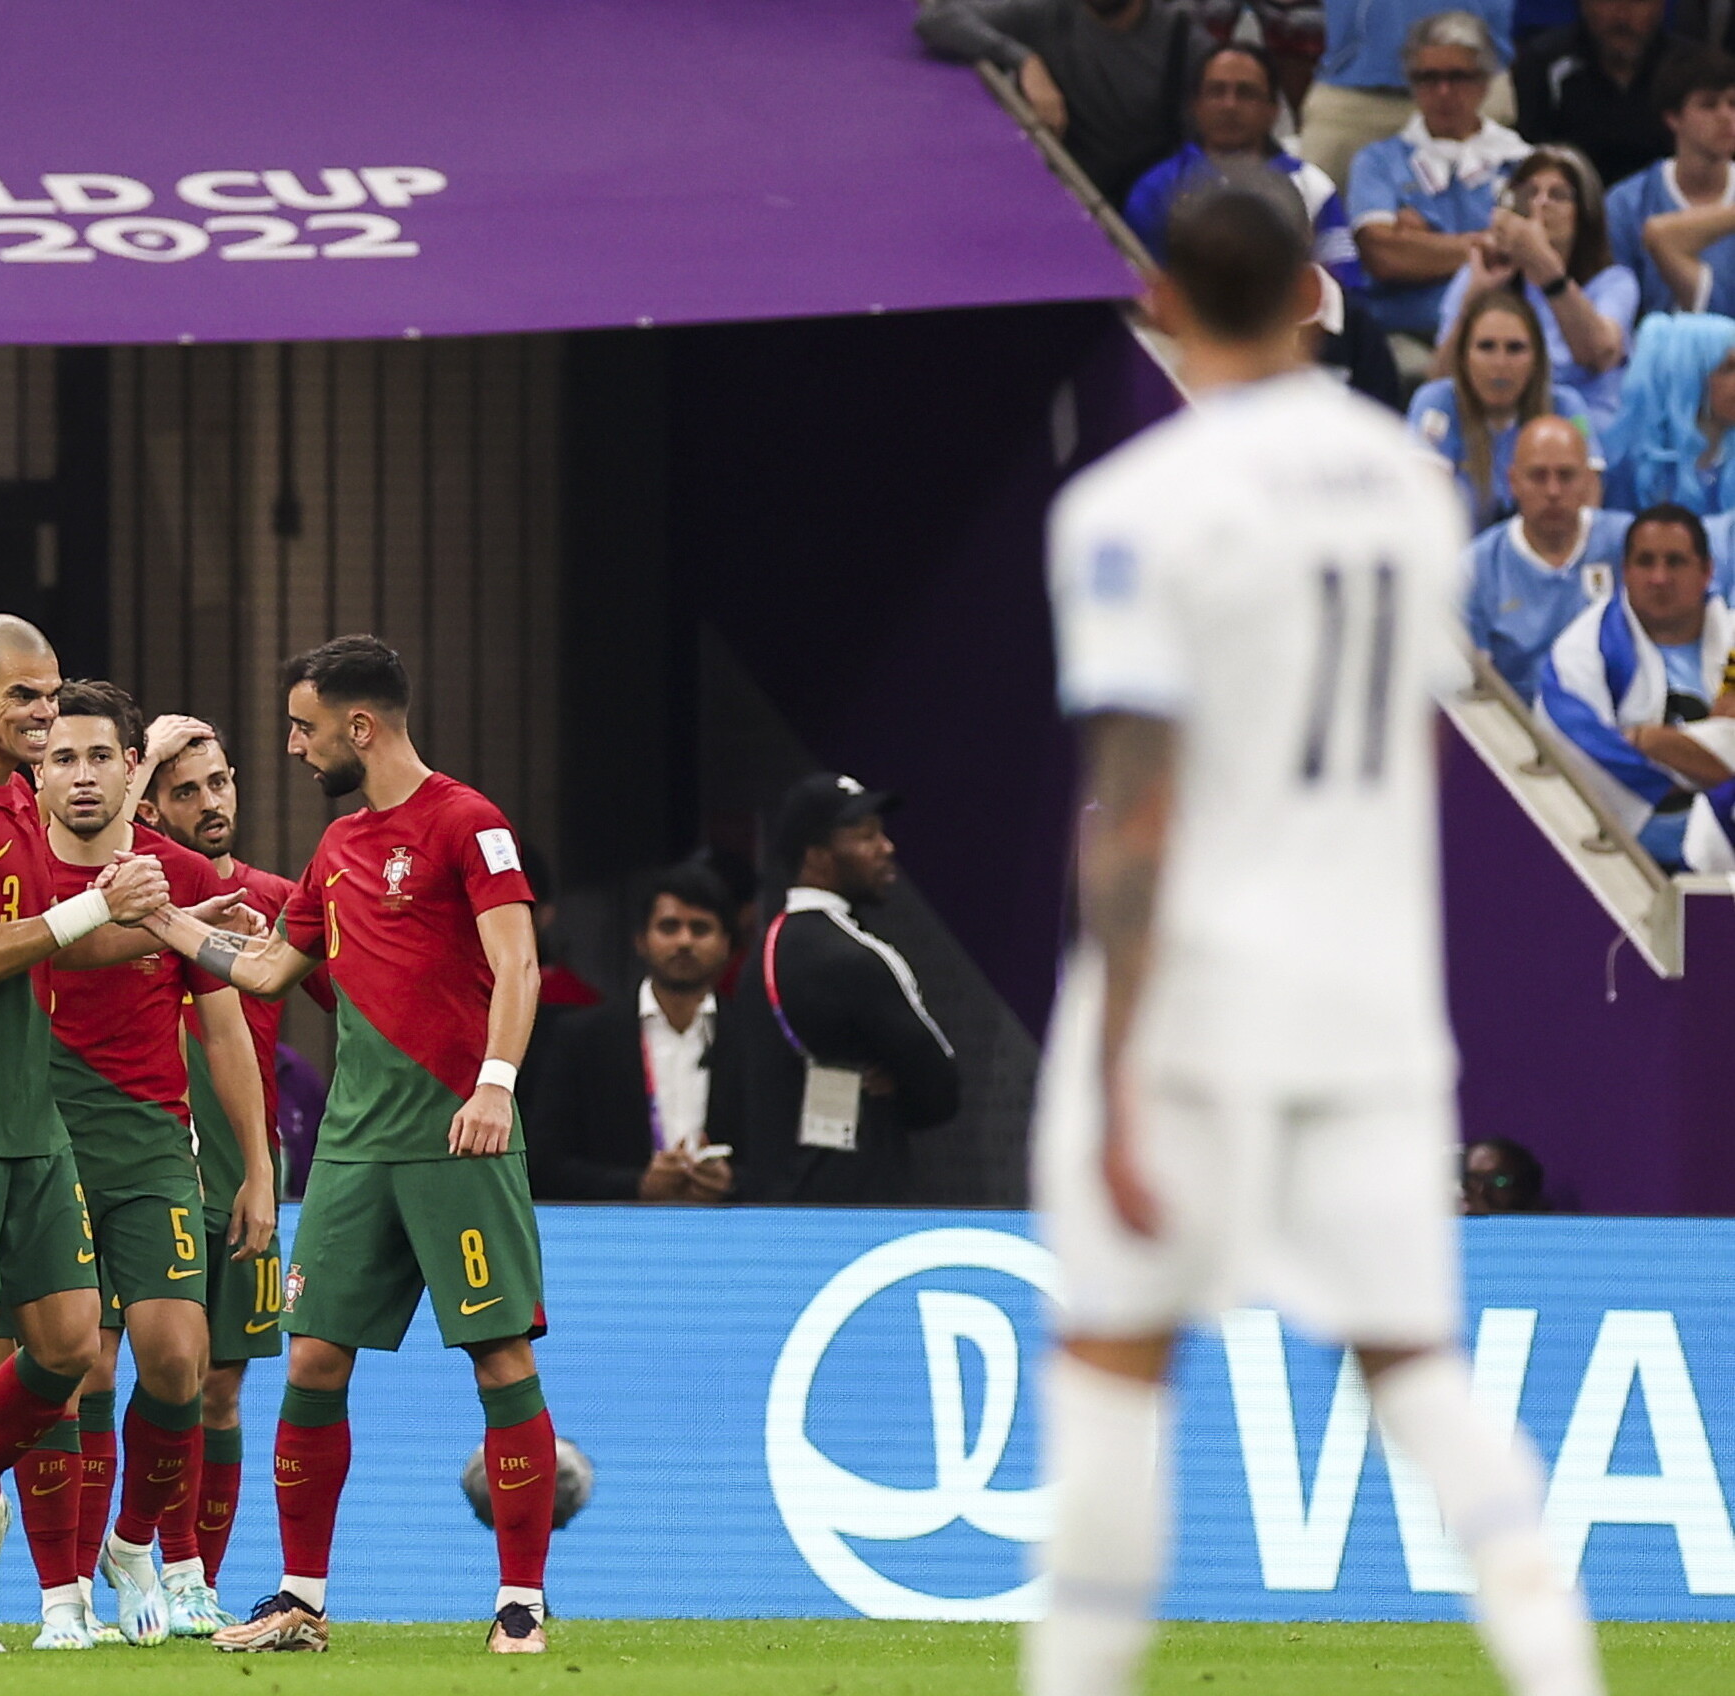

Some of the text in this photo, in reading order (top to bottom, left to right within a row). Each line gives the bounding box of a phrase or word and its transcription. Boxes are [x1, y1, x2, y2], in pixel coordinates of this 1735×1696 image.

[176, 166, 447, 211] CUP
[1295, 560, 1399, 789] 11
[0, 874, 21, 924] 3
[170, 1207, 196, 1261] 5
[460, 1228, 490, 1289] 8
[255, 1256, 280, 1313] 10
